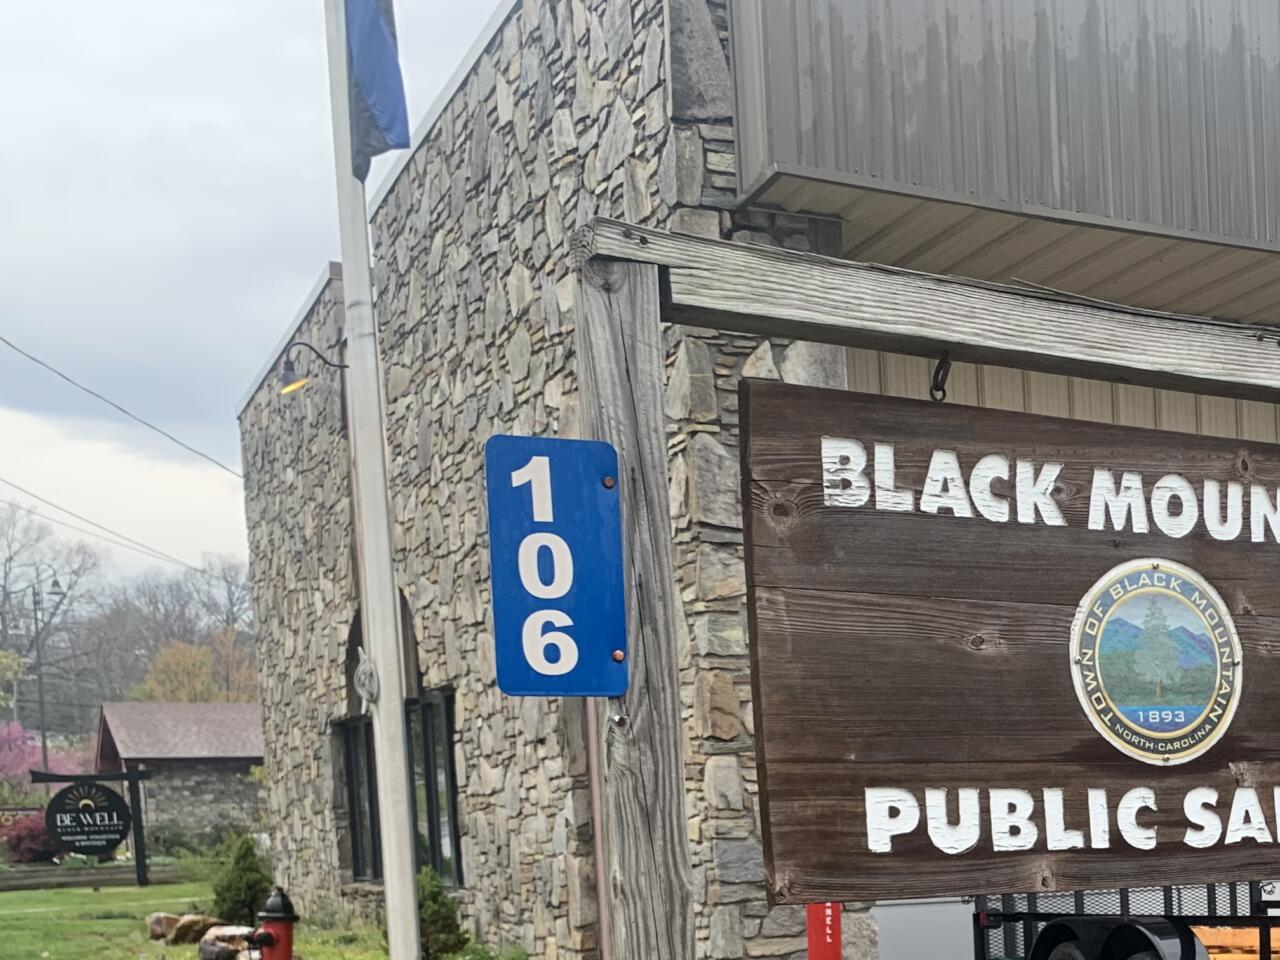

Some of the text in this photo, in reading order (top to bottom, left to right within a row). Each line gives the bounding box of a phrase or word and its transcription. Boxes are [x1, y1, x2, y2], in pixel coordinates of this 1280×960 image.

[820, 435, 1068, 526] BLACK
[511, 456, 579, 676] 106
[1081, 573, 1234, 727] TOWN OF BLACK MOUNTAIN
[1115, 724, 1212, 751] NORTH CAROLINA
[1137, 710, 1185, 723] 1893
[56, 811, 123, 826] BE WELL
[864, 786, 1158, 855] PUBLIC
